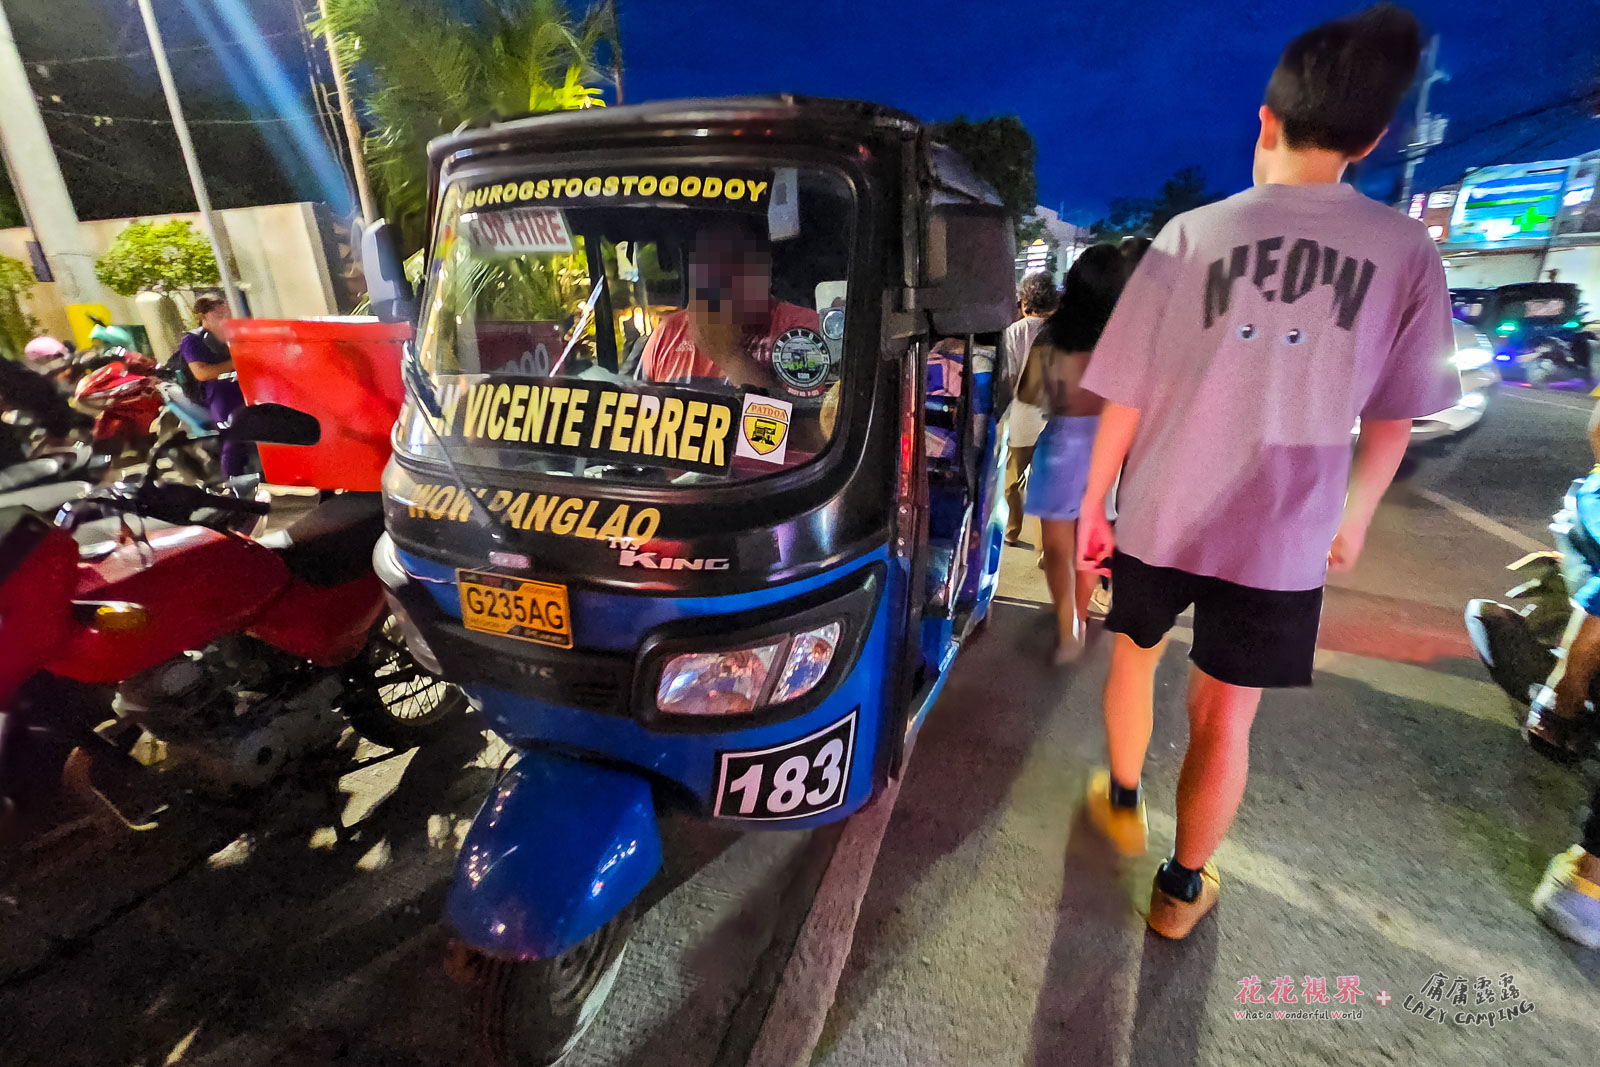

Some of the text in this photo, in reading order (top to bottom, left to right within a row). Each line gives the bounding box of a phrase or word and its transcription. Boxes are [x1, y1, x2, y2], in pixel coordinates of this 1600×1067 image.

[468, 209, 567, 246] FOR HIRE
[1203, 235, 1377, 331] MEOW
[463, 383, 590, 447] VICENTE
[590, 390, 732, 467] FERRER
[751, 404, 786, 419] PATDOA
[408, 483, 662, 546] WOW PANGLAO
[618, 549, 731, 571] KING
[466, 586, 564, 630] G235AG
[728, 737, 845, 814] 183
